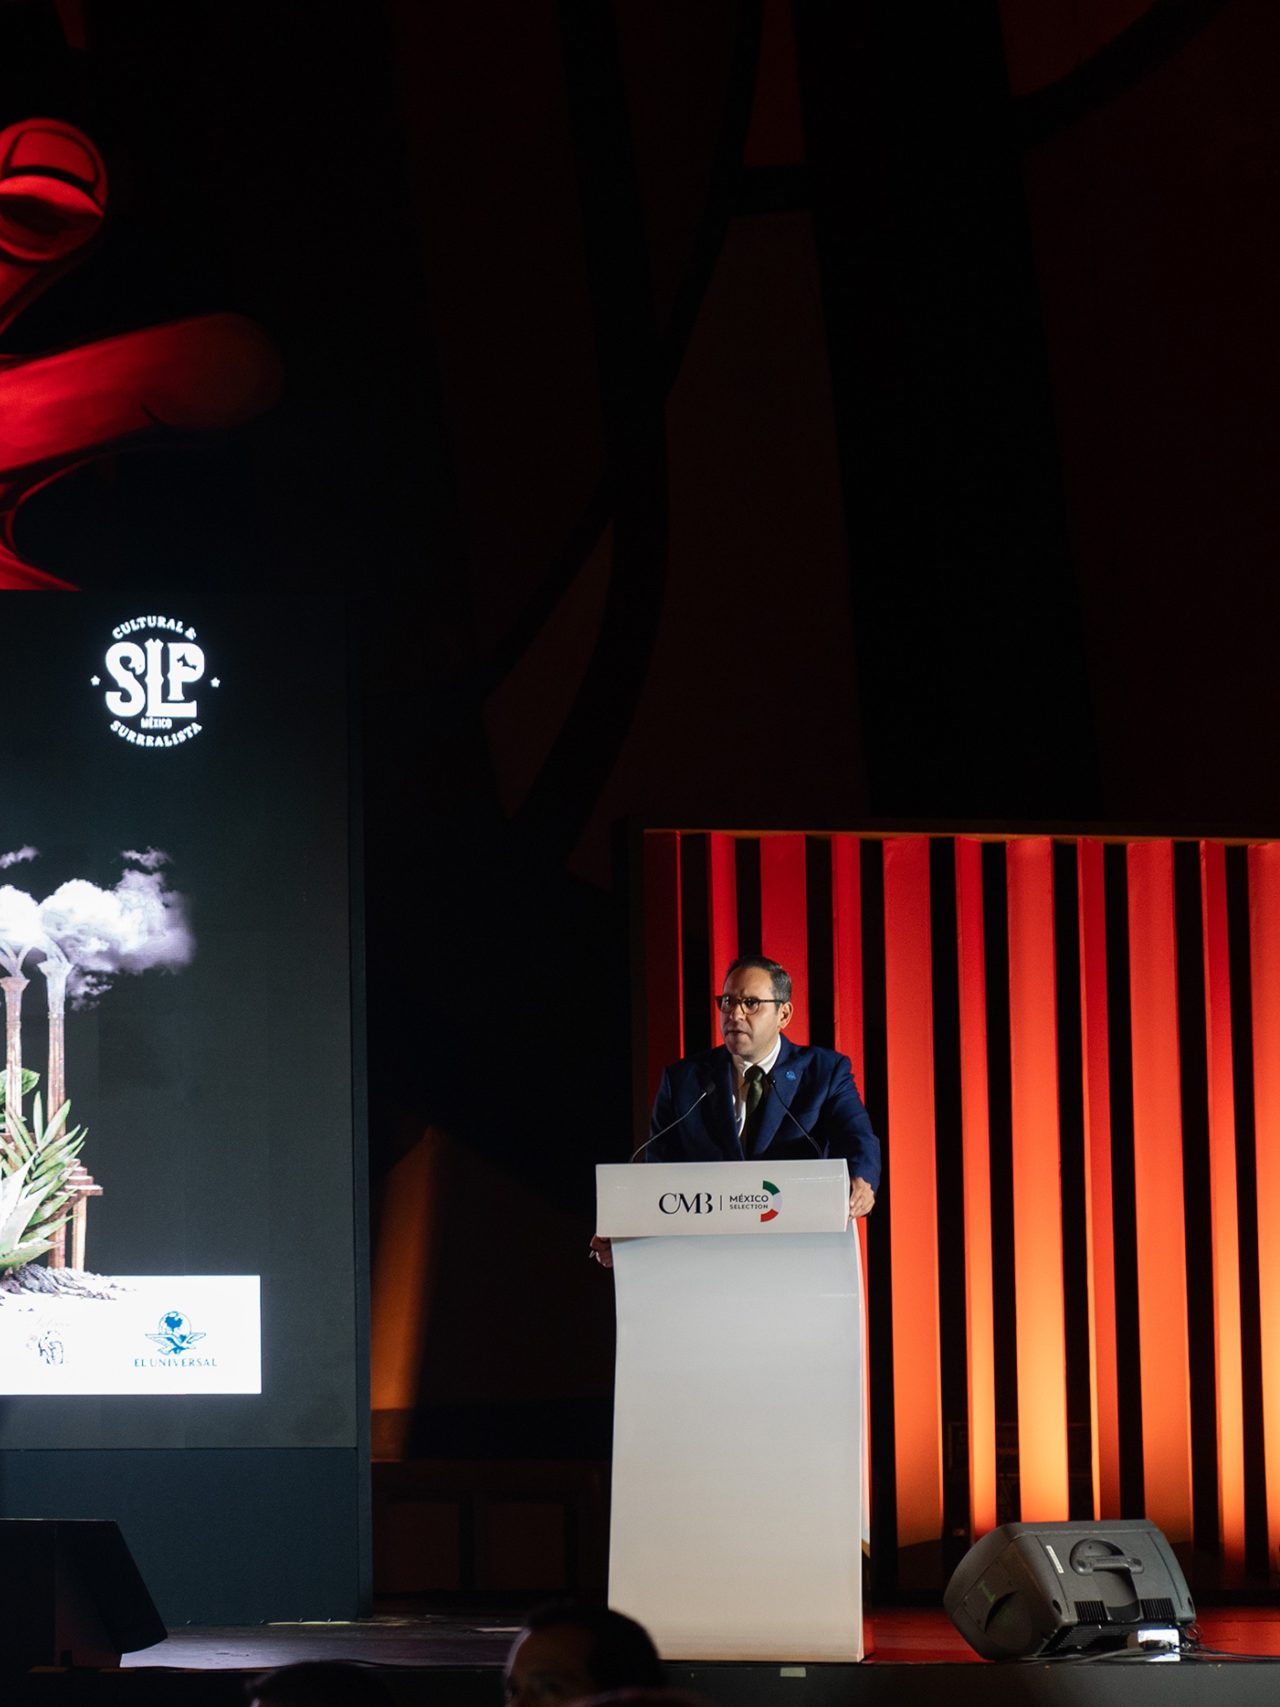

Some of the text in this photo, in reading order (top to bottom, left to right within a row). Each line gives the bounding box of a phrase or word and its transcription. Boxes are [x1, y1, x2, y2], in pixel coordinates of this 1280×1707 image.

[112, 615, 183, 640] CULTURAL
[105, 638, 205, 718] SLP
[659, 1192, 713, 1214] CMB
[729, 1194, 769, 1203] MÉXICO
[134, 1358, 218, 1368] EL UNIVERSAL
